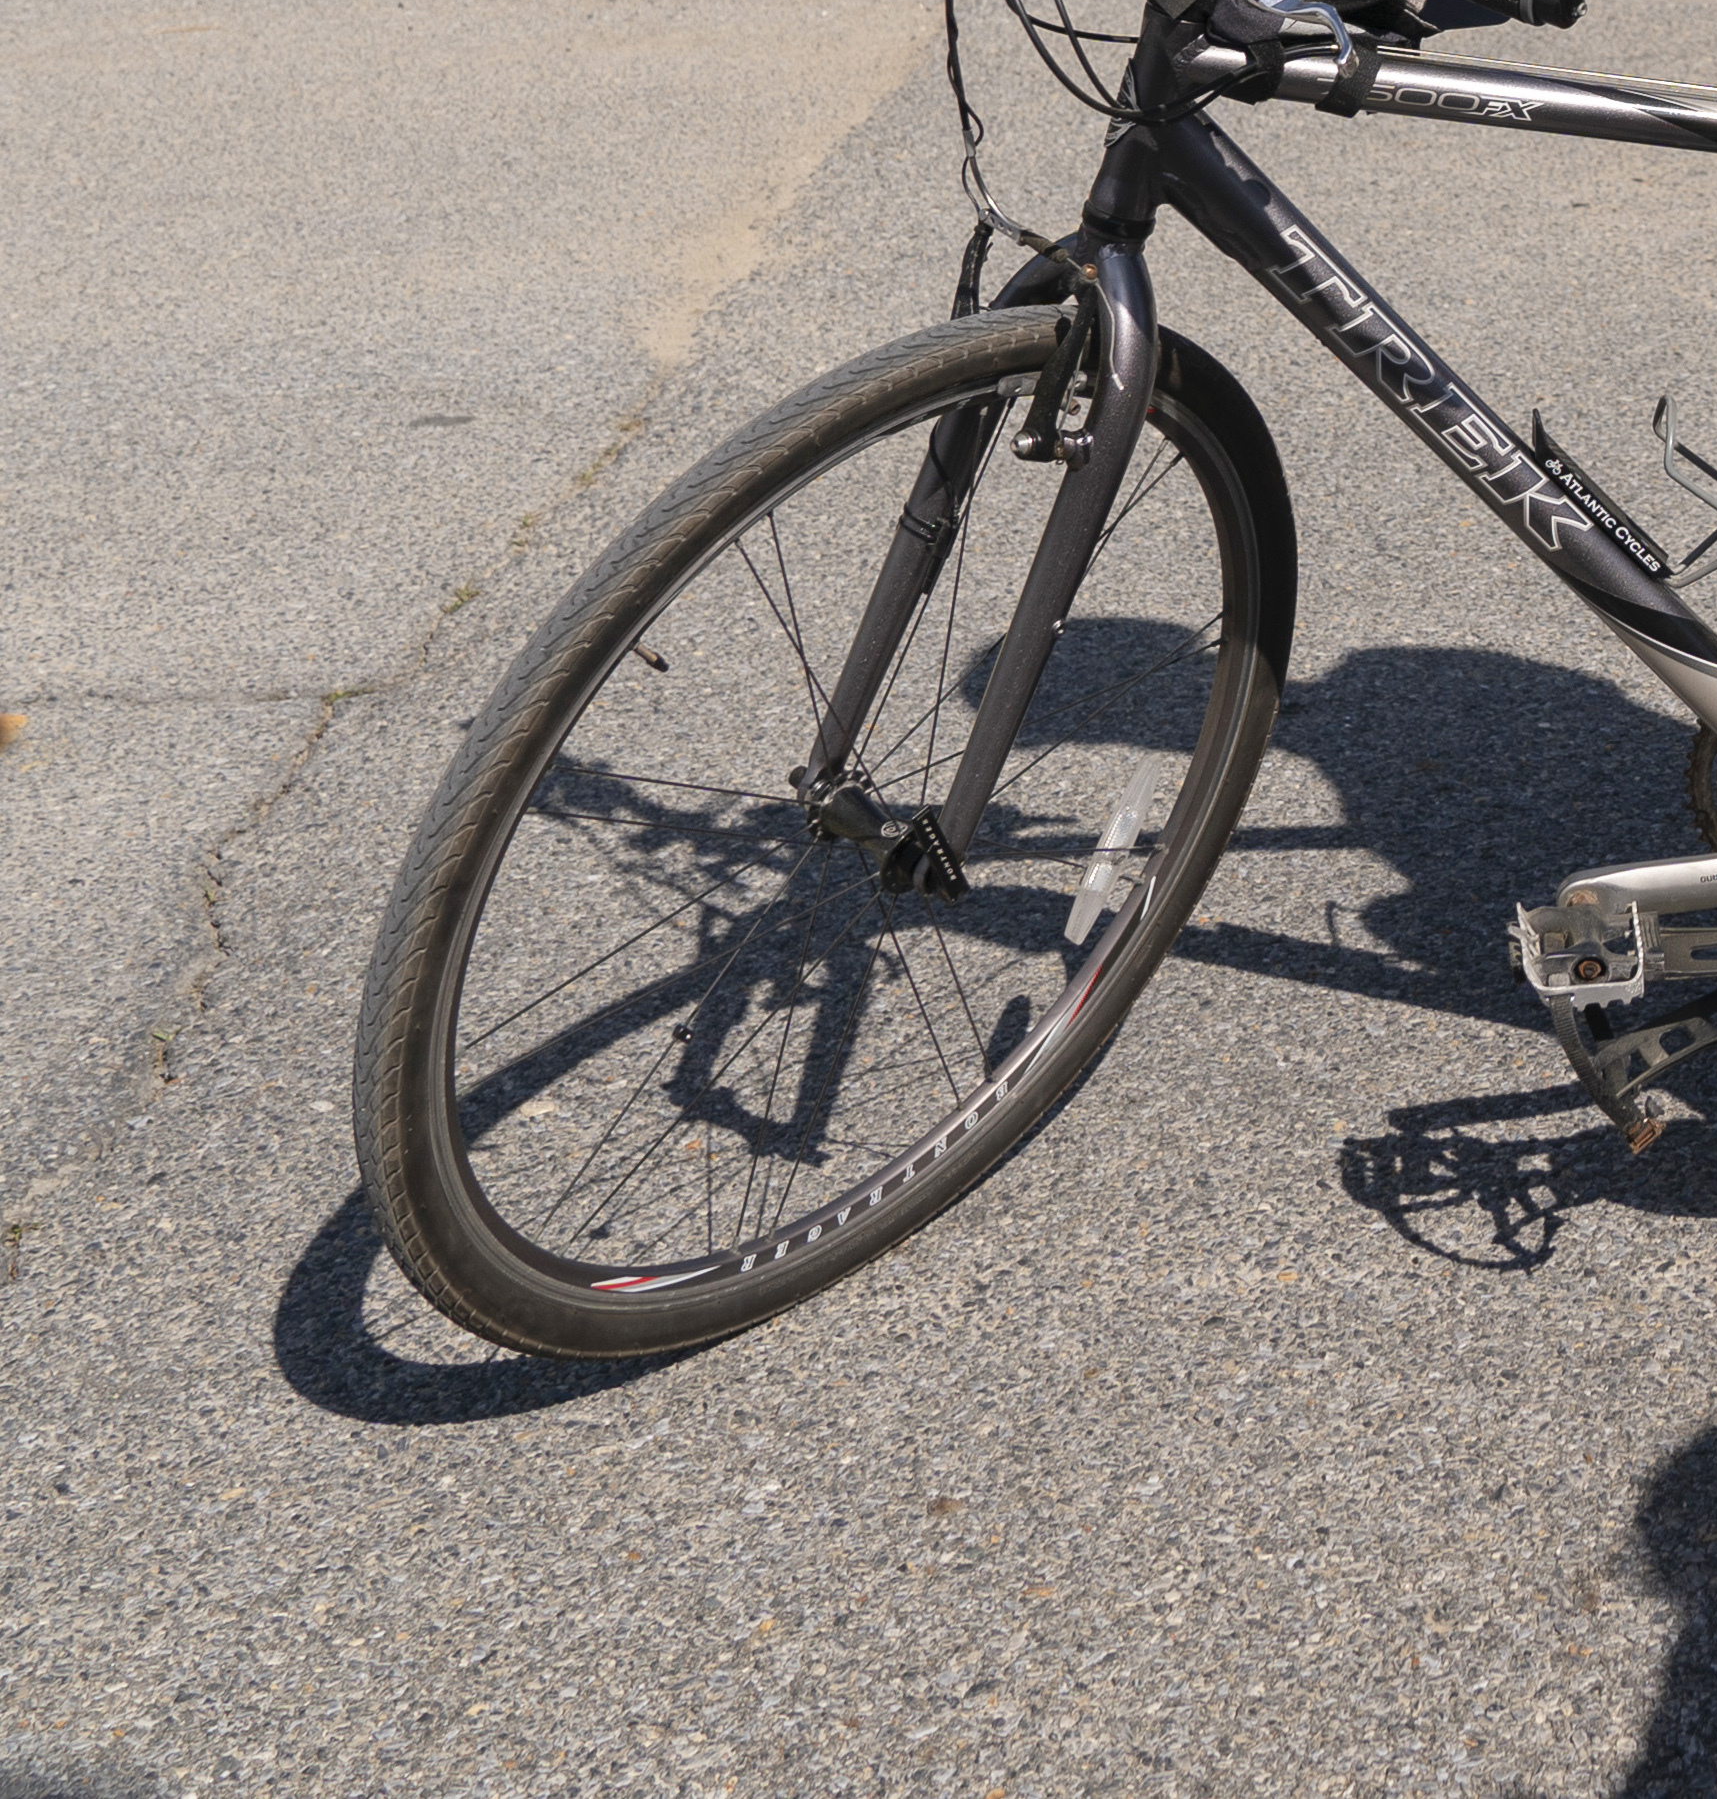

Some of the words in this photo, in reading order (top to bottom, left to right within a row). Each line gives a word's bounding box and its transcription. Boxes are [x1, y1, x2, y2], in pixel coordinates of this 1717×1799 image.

[1269, 224, 1594, 554] TREK
[1559, 472, 1617, 529] ATLANTIC
[1615, 526, 1661, 573] CYCLES
[740, 1081, 1010, 1272] BONTRAGER
